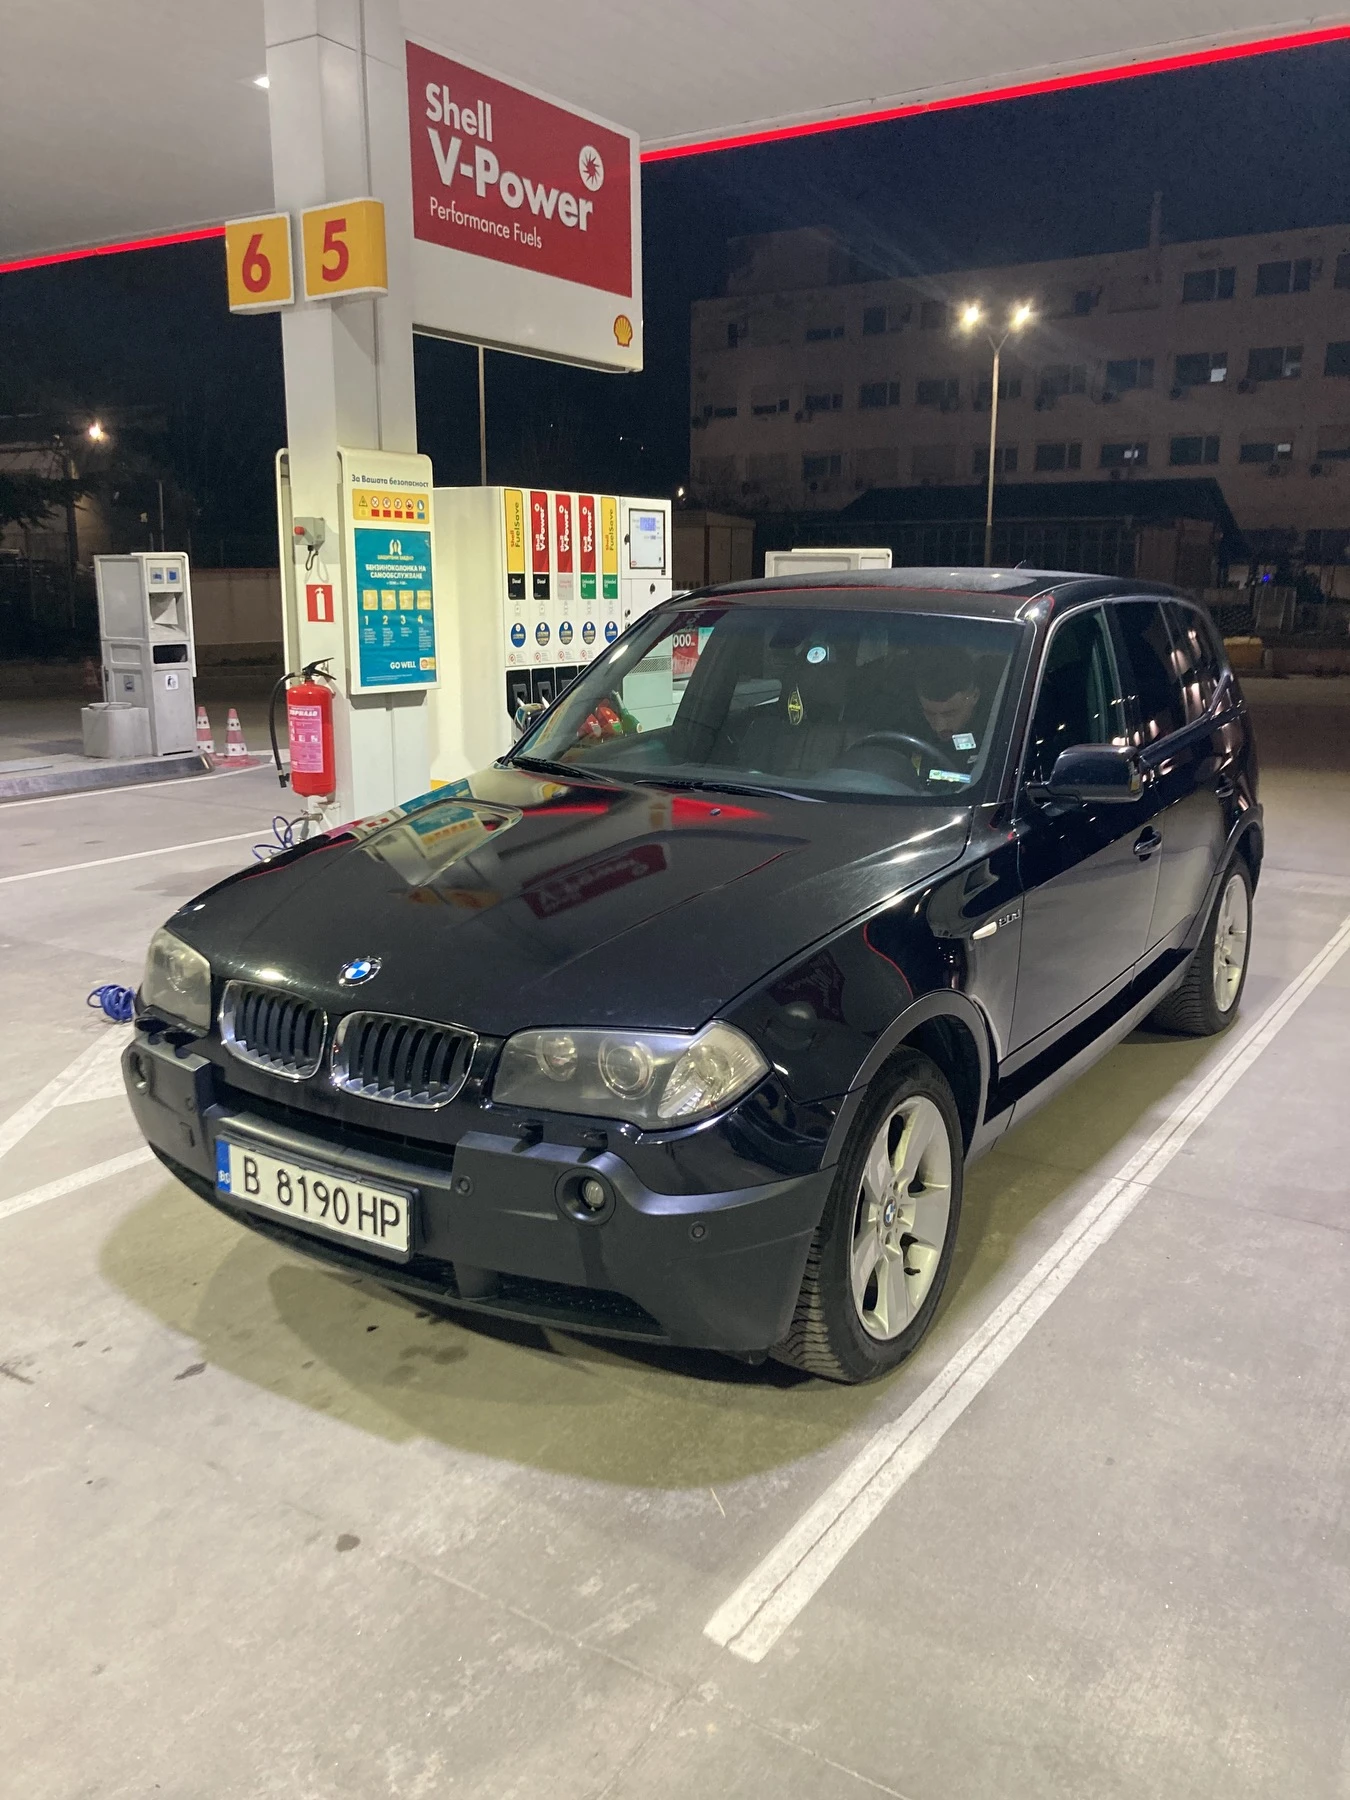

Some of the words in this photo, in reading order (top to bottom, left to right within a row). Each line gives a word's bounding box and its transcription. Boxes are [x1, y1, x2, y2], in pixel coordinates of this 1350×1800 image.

[425, 82, 493, 142] Shell
[427, 126, 593, 232] V-Power
[322, 218, 349, 282] 5
[430, 196, 510, 239] Performance
[514, 222, 542, 249] Fuels
[242, 234, 271, 293] 6
[351, 474, 361, 482] За
[361, 475, 388, 484] Вашата
[389, 477, 429, 488] безопасност
[364, 615, 369, 625] 1
[382, 615, 388, 625] 2
[400, 615, 406, 625] 3
[417, 615, 423, 624] 4
[401, 661, 416, 669] WELL
[243, 1156, 260, 1195] B
[277, 1168, 350, 1226] 8190
[357, 1191, 400, 1238] HP
